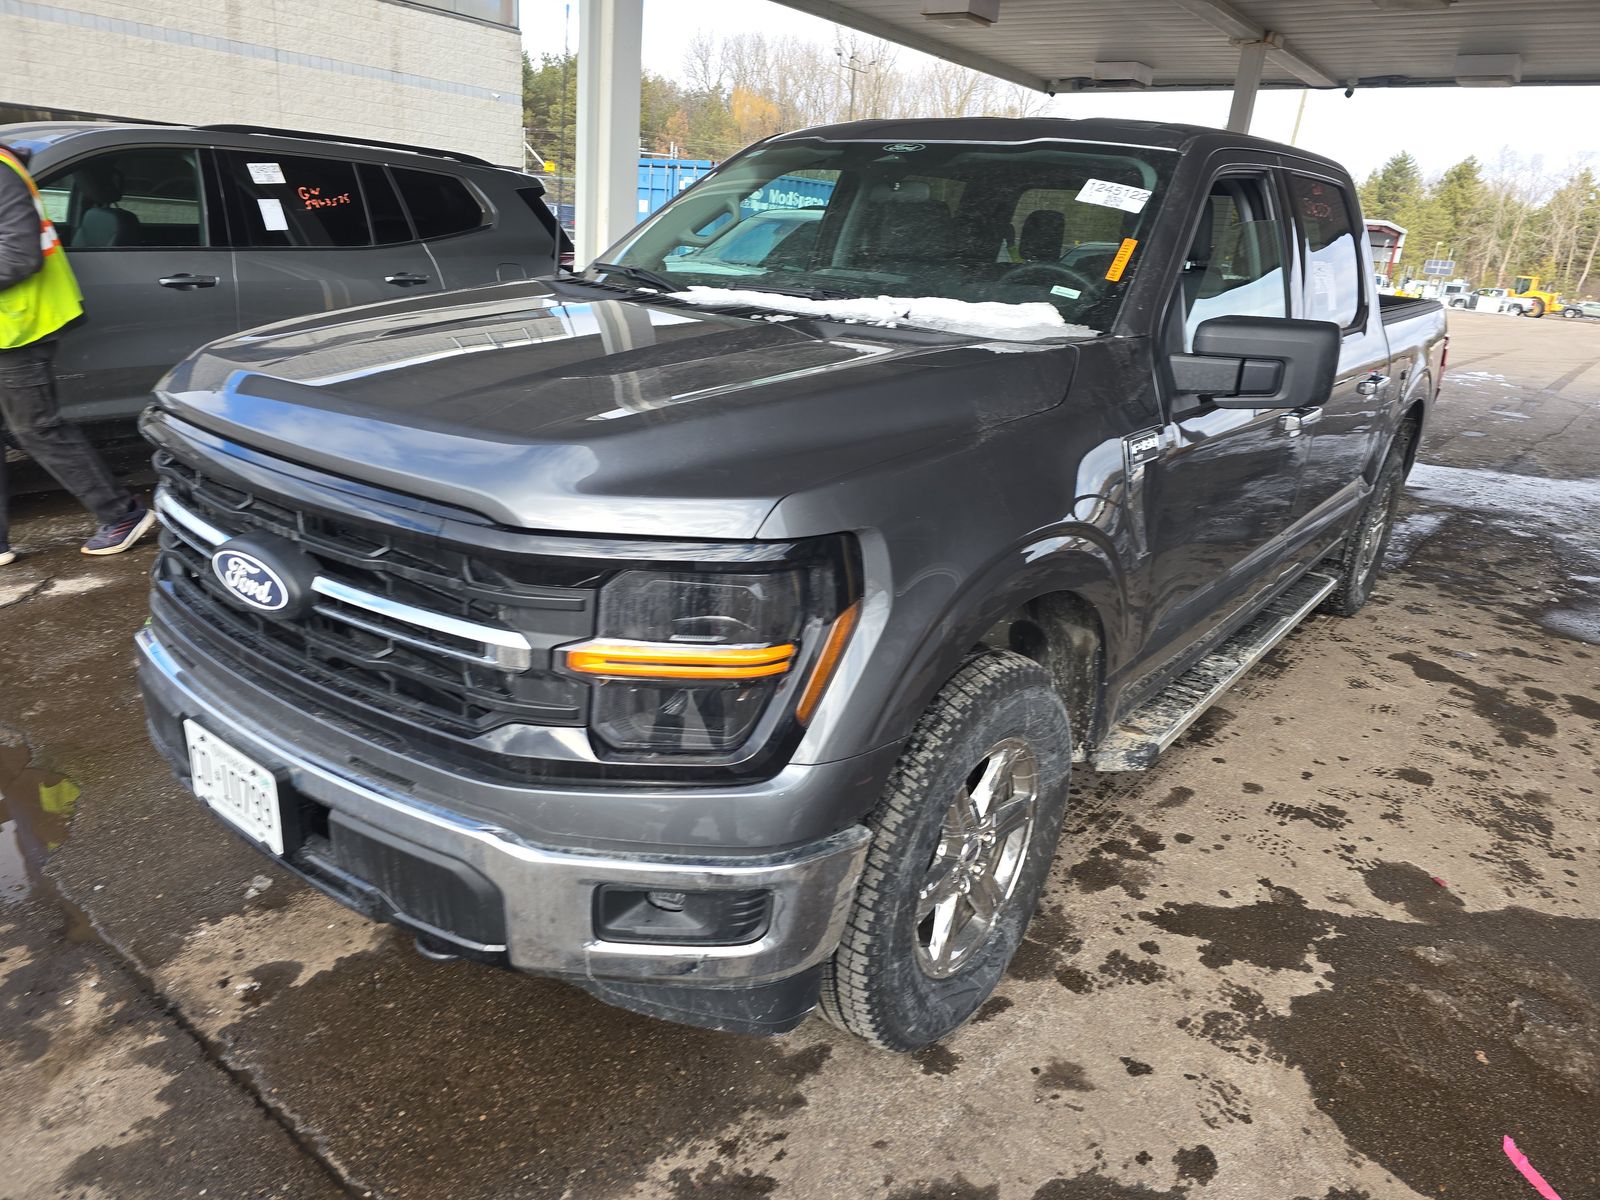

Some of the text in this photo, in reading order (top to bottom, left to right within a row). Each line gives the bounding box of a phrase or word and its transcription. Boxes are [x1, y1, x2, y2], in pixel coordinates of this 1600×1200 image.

[769, 189, 825, 208] ModSpace
[1090, 181, 1151, 202] 1245122
[224, 556, 274, 604] Ford
